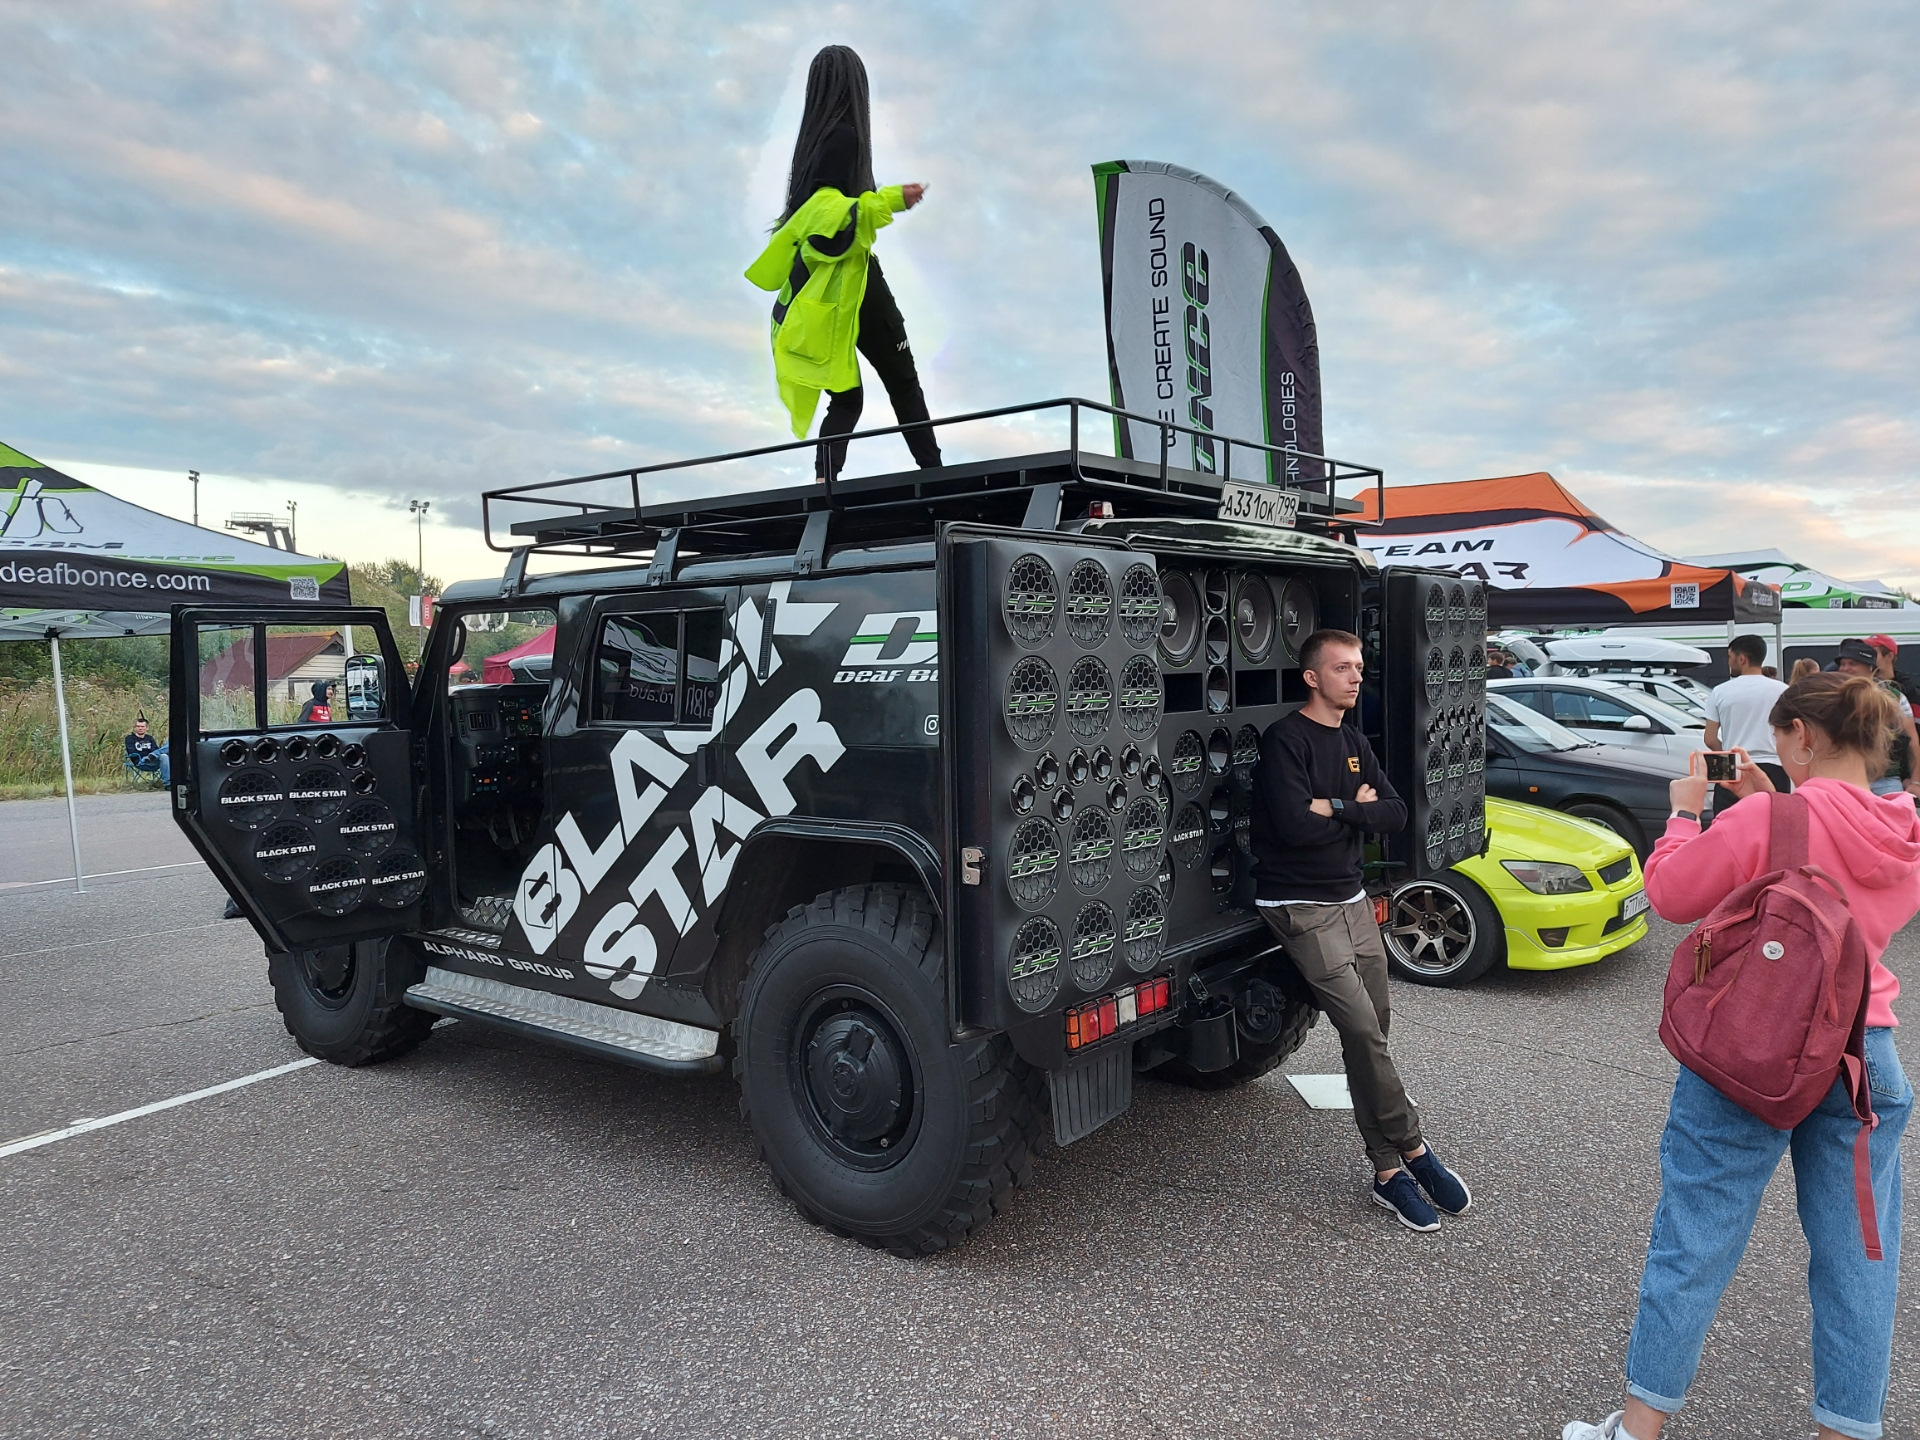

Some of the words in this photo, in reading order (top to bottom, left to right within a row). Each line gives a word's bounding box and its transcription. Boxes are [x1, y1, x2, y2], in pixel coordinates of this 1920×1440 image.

[1148, 197, 1168, 288] SOUND
[1153, 296, 1174, 400] CREATE
[1281, 372, 1300, 483] HNOLOGIES
[1278, 496, 1296, 517] 799
[0, 561, 211, 592] deafbonce.com
[513, 580, 840, 955] BLACK
[221, 795, 255, 804] BLACK
[256, 793, 283, 802] STAR
[289, 791, 321, 799] BLACK
[340, 825, 370, 834] BLACK
[371, 823, 395, 831] STAR
[256, 848, 289, 858] BLACK
[290, 845, 316, 854] STAR
[584, 687, 847, 1000] STAR
[309, 883, 341, 893] BLACK
[342, 878, 366, 887] STAR
[372, 874, 401, 885] BLACK
[402, 870, 425, 880] STAR
[422, 941, 504, 967] ALPHARD
[507, 958, 575, 980] GROUP
